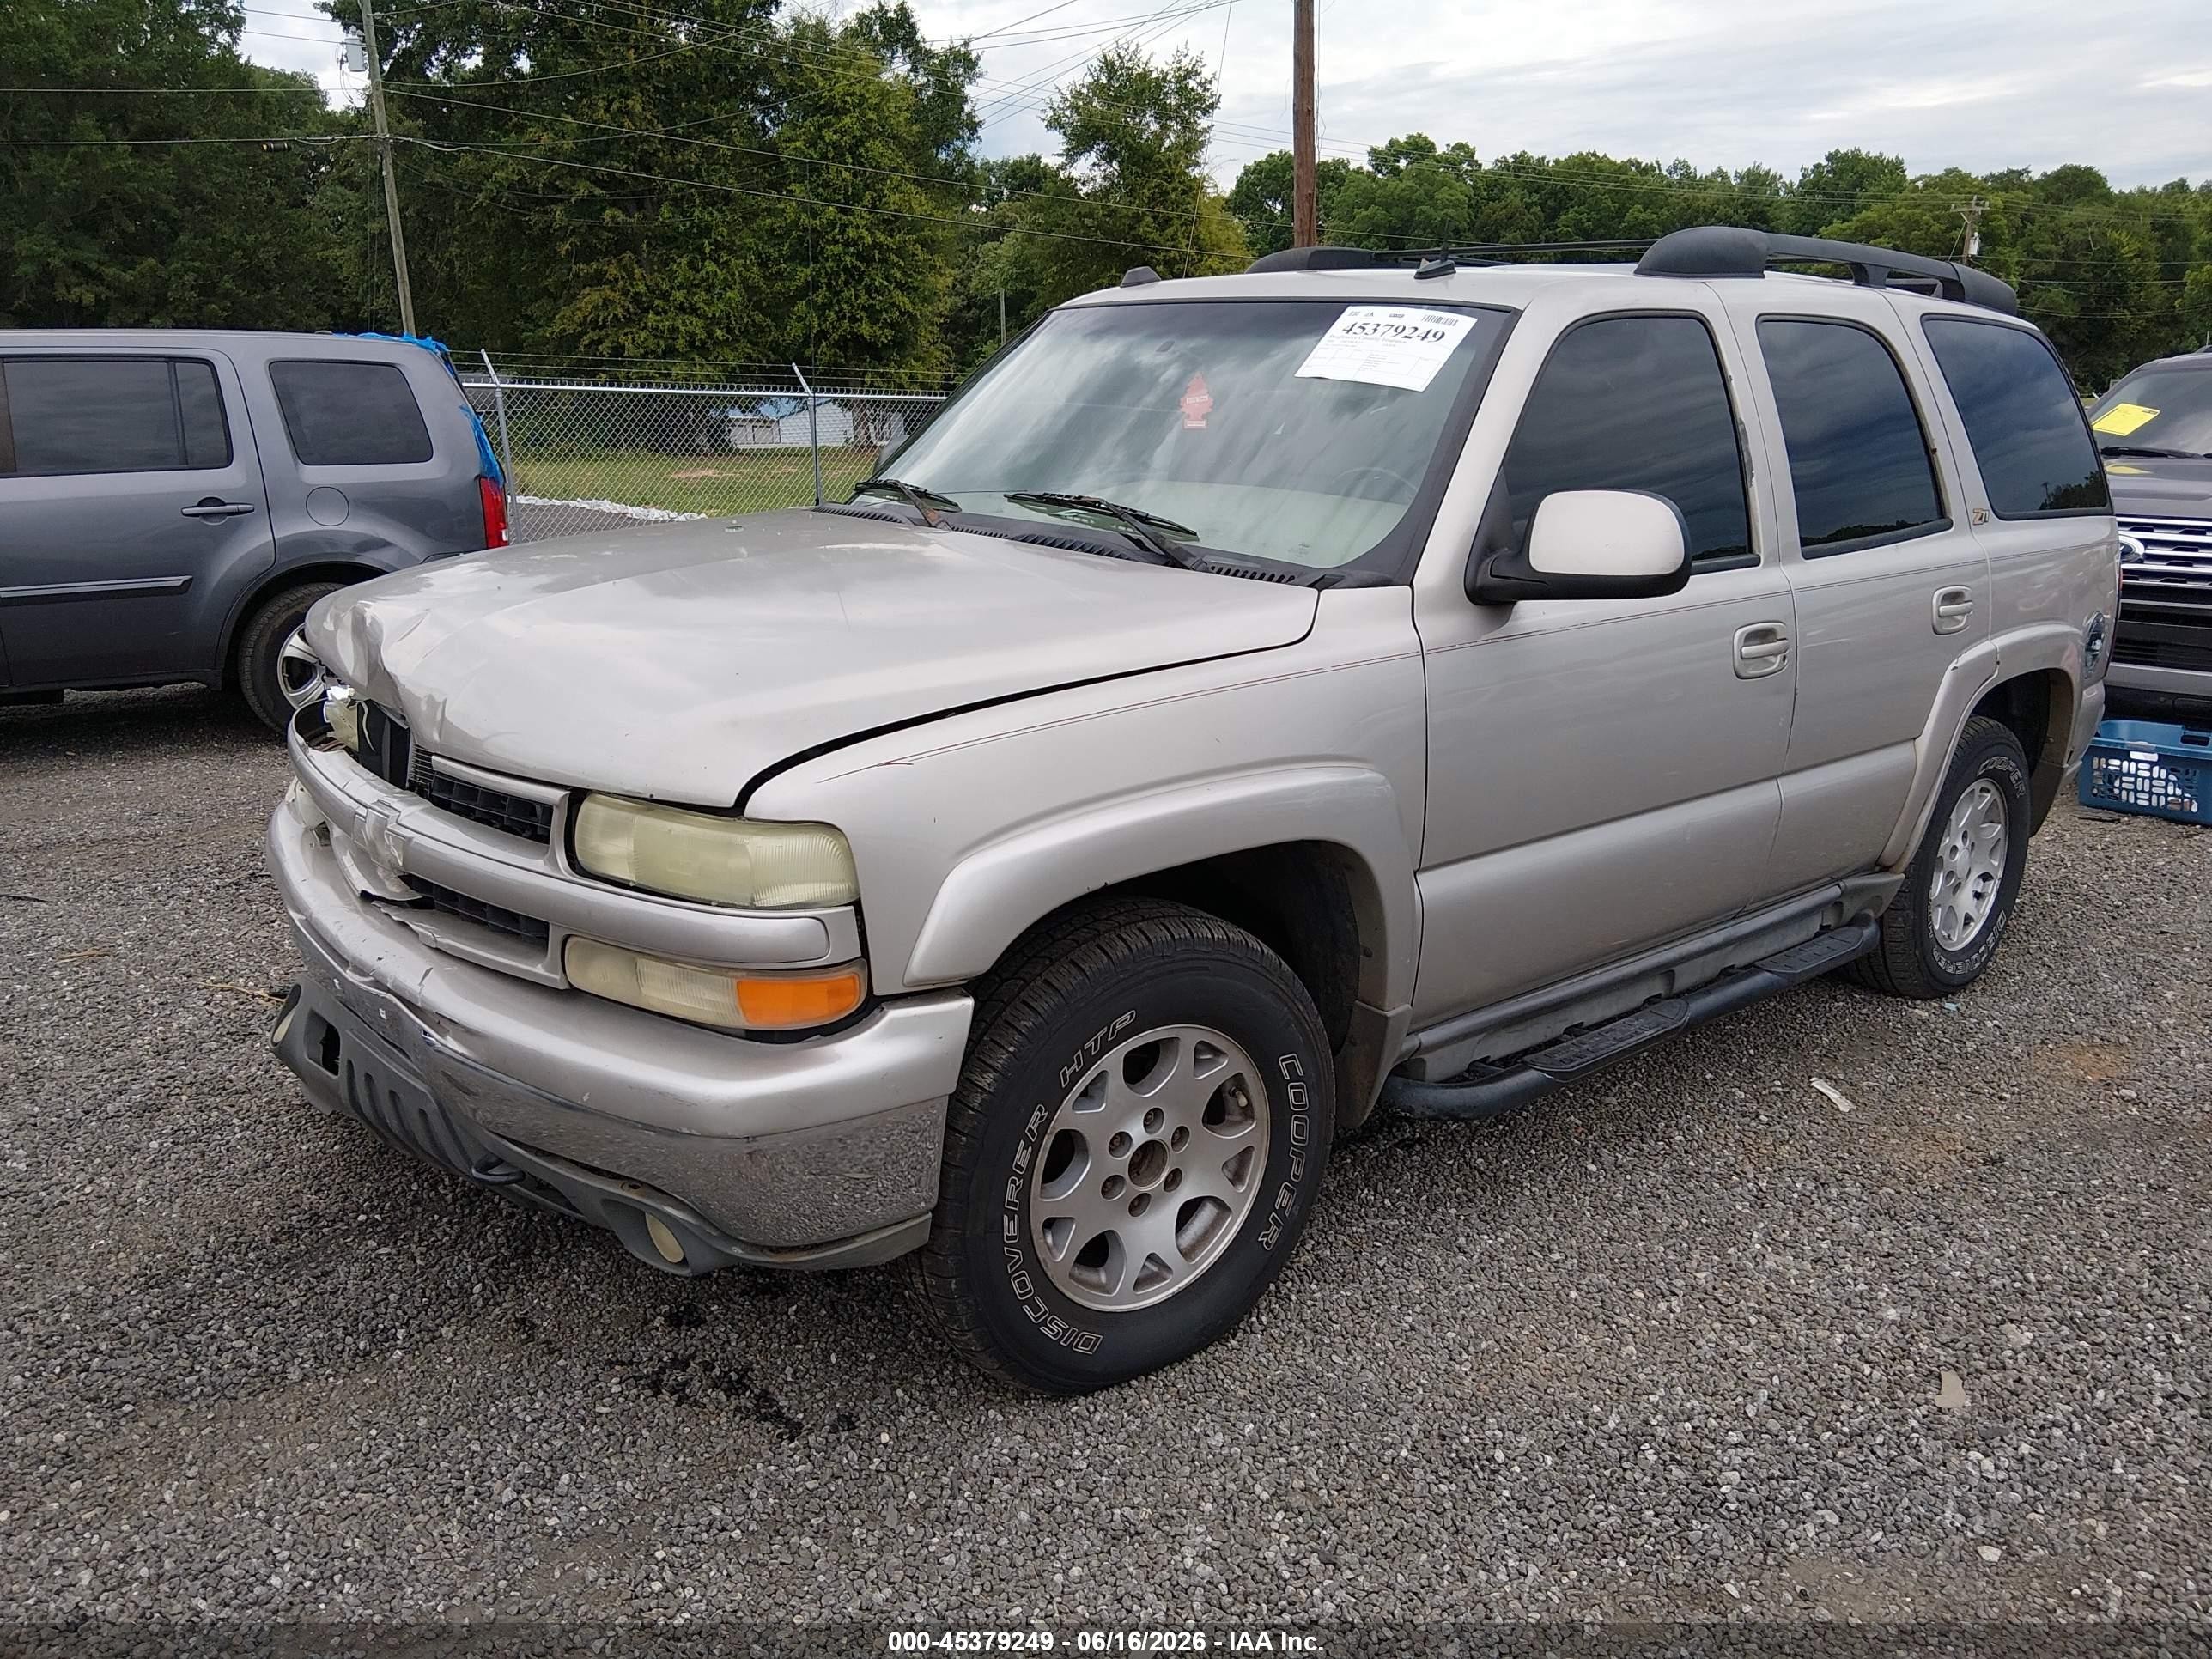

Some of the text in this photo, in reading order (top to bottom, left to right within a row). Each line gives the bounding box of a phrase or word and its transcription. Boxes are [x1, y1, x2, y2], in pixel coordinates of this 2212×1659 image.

[1342, 321, 1446, 343] 45379249
[1977, 756, 2026, 799] COOPER
[1004, 1009, 1137, 1356] DISCOVERER HTP
[1257, 1053, 1310, 1252] COOPER
